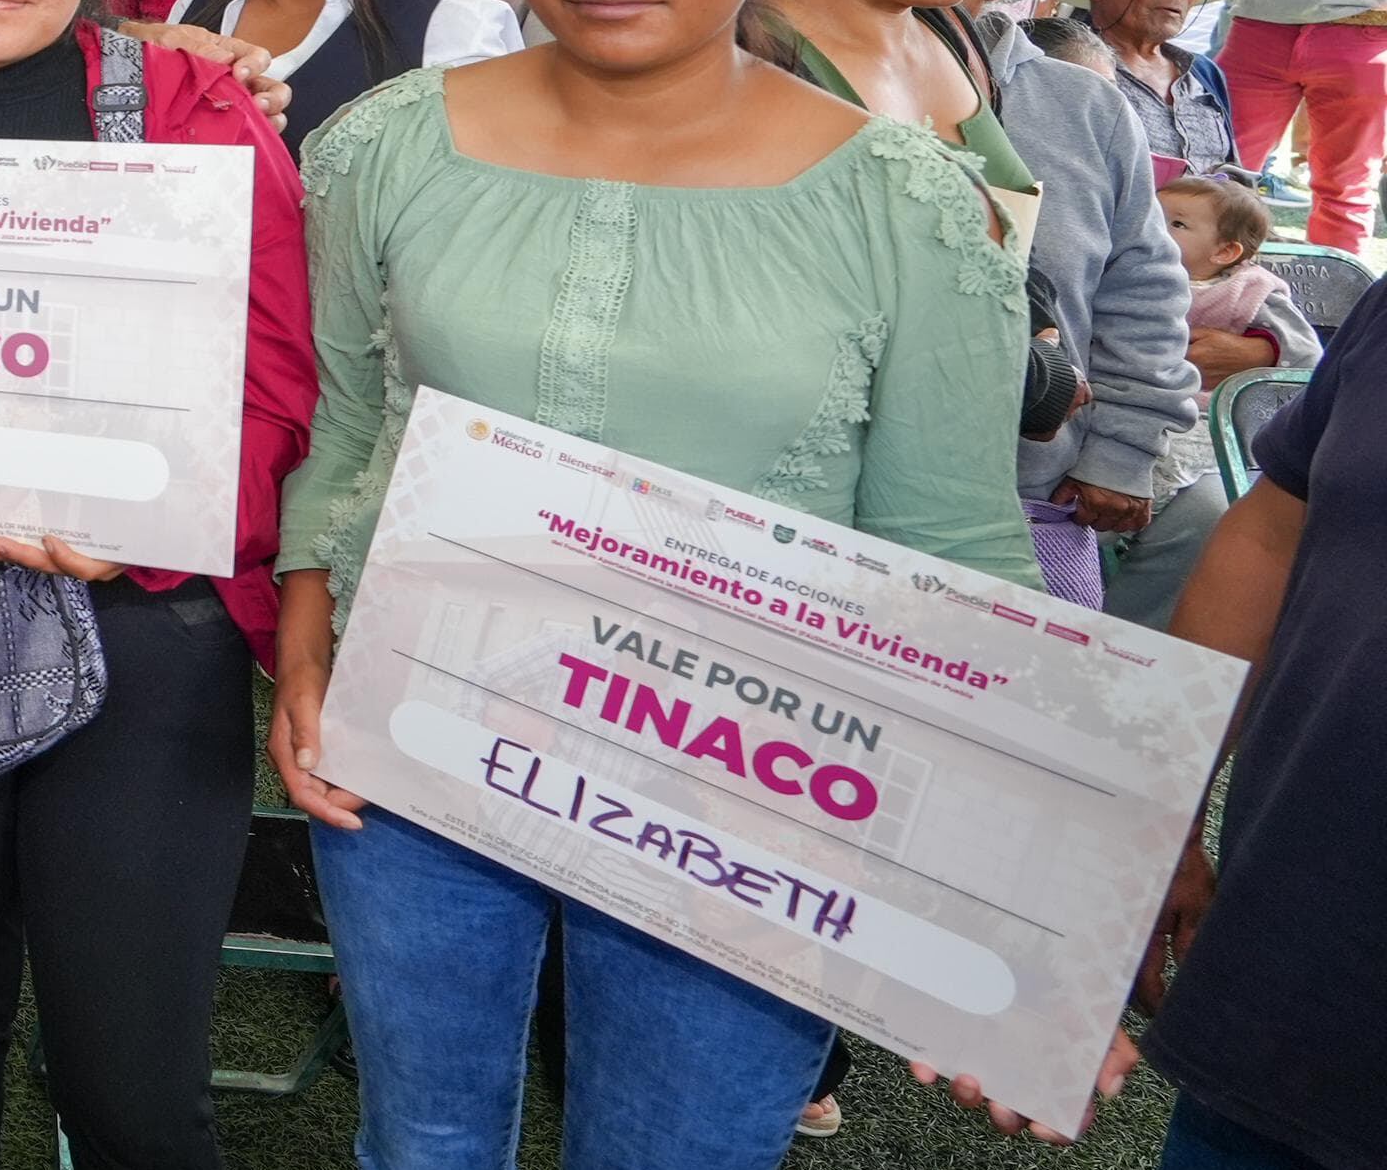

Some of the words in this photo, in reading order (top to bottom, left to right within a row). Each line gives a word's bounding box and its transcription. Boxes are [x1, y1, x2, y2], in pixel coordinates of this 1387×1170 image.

[490, 431, 543, 460] México
[557, 450, 617, 480] Bienestar
[724, 506, 767, 527] PUEBLA
[539, 510, 763, 605] “Mejoramiento
[769, 599, 788, 616] a
[796, 603, 825, 630] la
[837, 617, 1008, 690] Vivienda”
[665, 537, 741, 573] ENTREGA
[746, 566, 769, 582] DE
[771, 577, 865, 616] ACCIONES
[559, 653, 878, 821] TINACO
[593, 616, 699, 680] VALE
[705, 662, 801, 721] POR
[811, 703, 881, 752] UN
[479, 736, 857, 943] ELIZABETH
